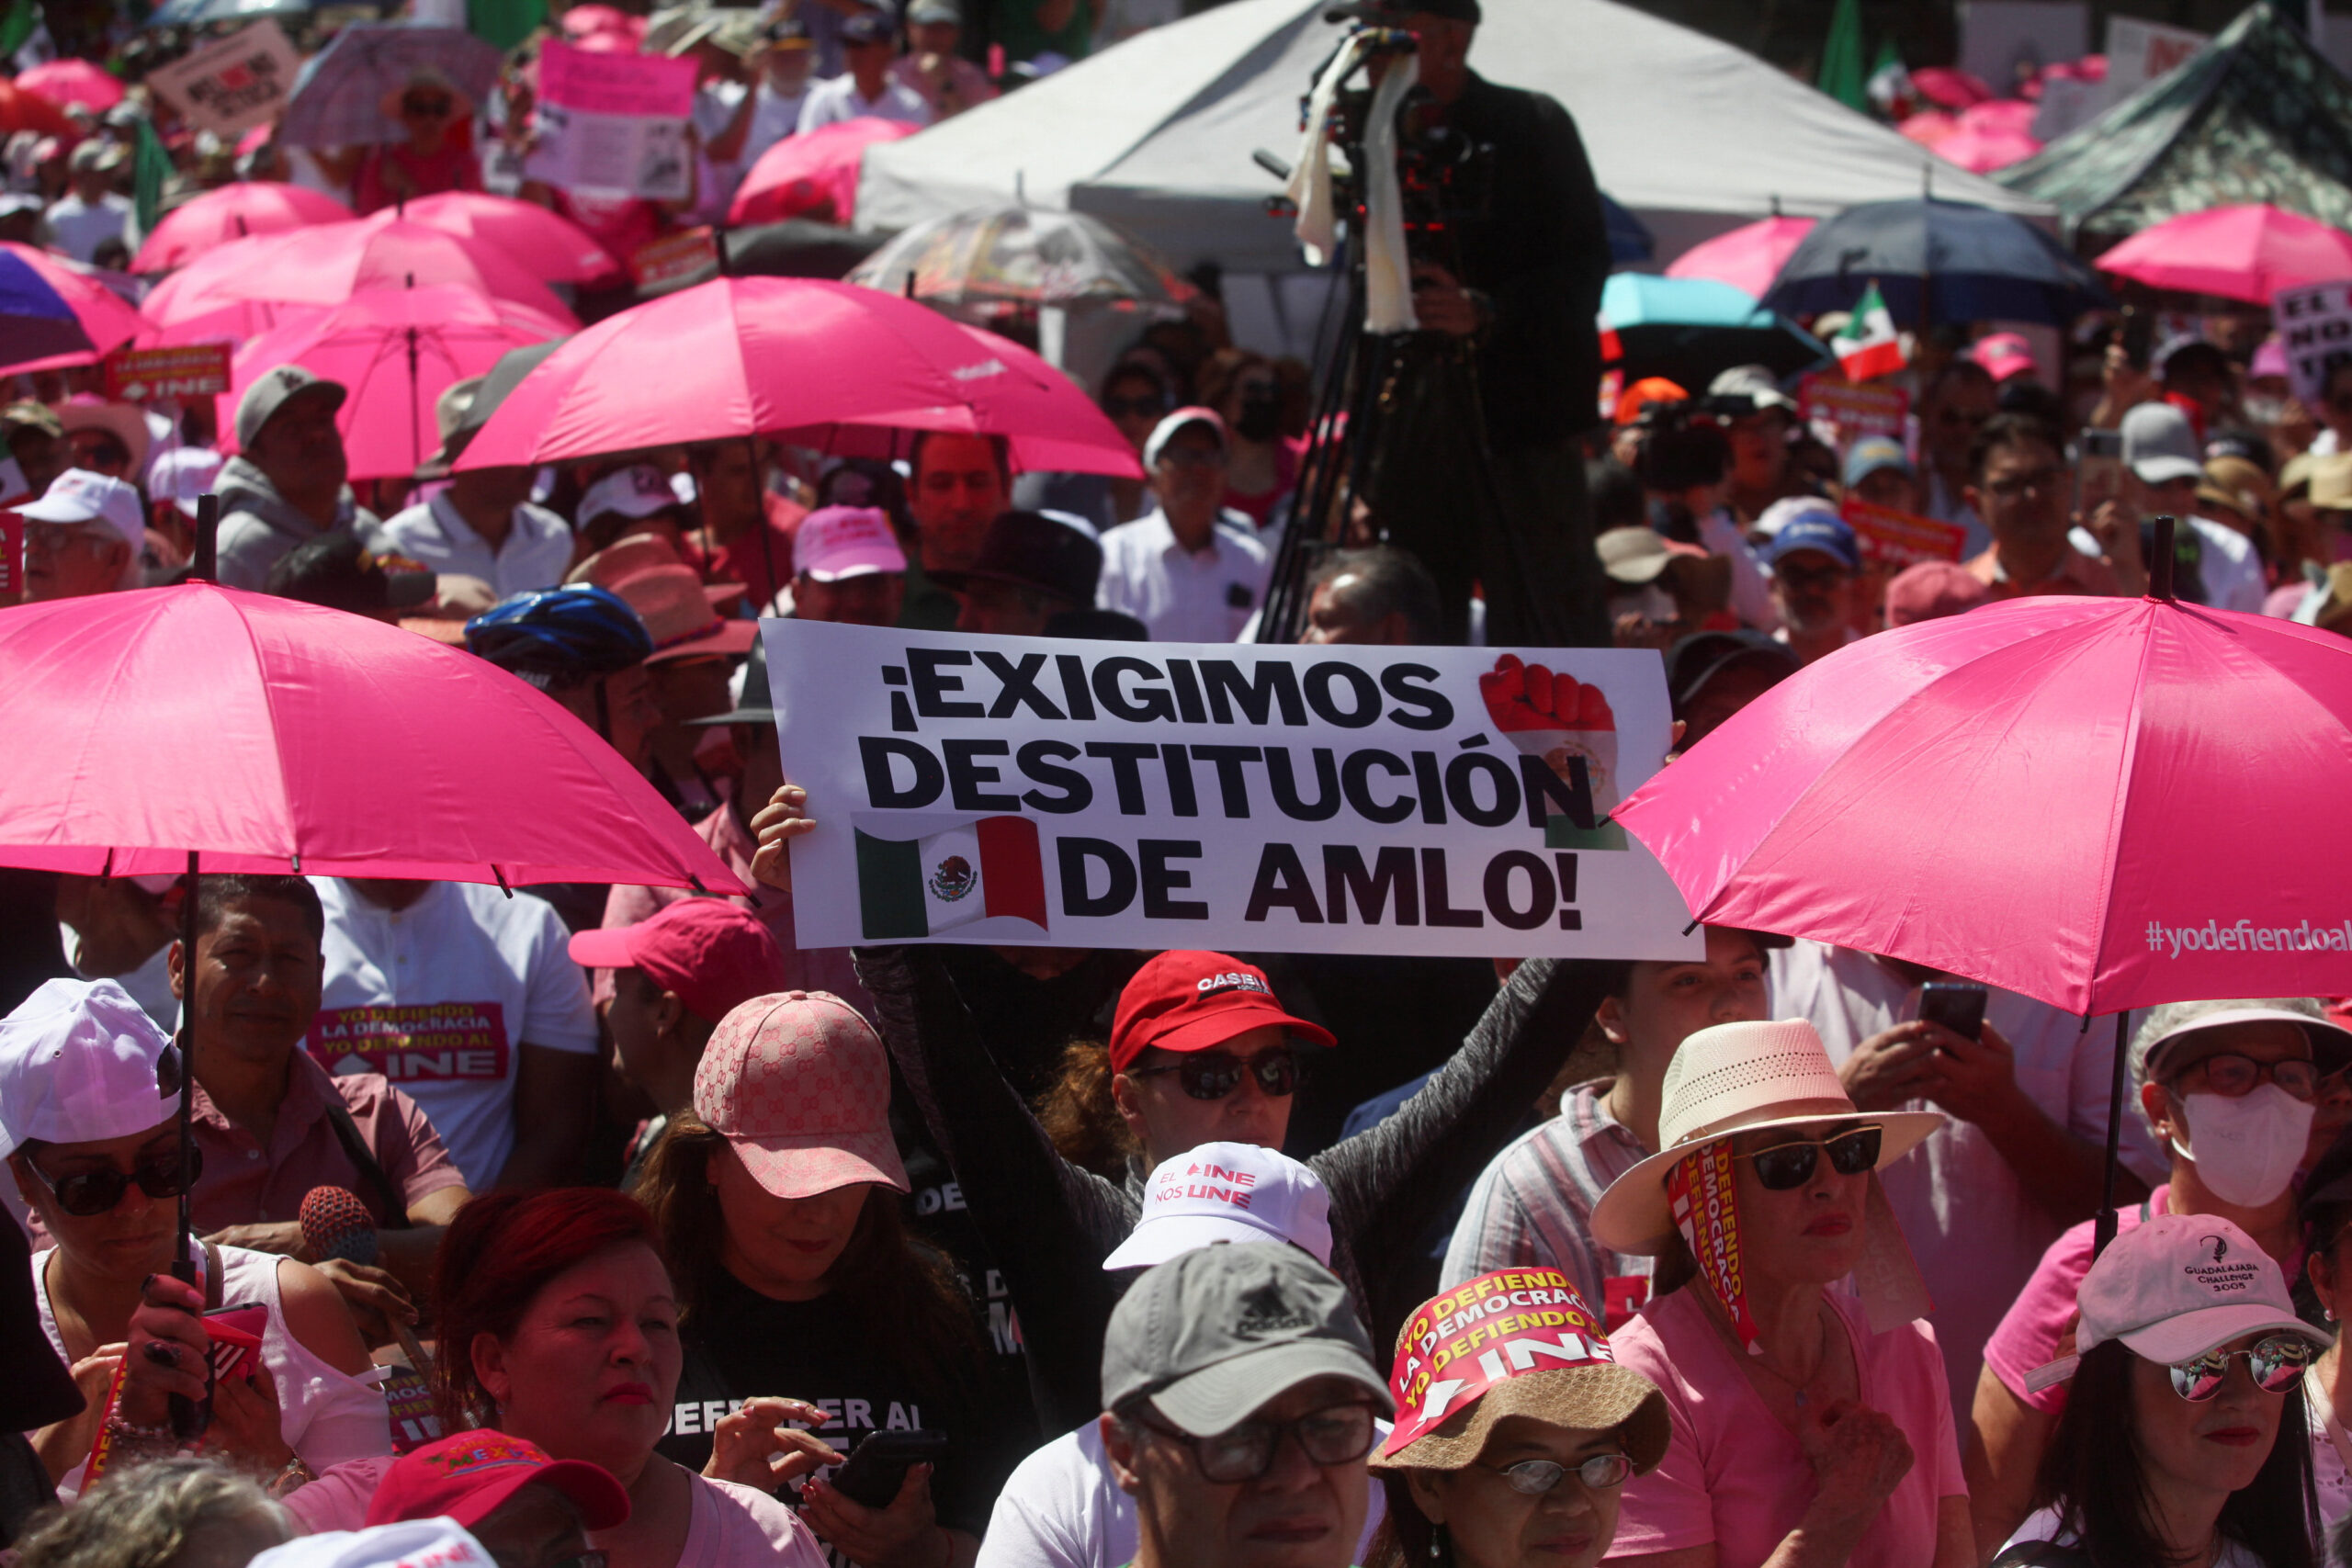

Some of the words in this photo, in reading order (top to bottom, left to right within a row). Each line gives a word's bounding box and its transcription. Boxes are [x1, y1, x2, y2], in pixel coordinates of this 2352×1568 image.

[881, 647, 1453, 732] ¡EXIGIMOS
[858, 733, 1595, 829] DESTITUCIÓN
[1057, 837, 1208, 919] DE
[1245, 843, 1581, 931] AMLO!
[322, 1023, 348, 1038] LA
[354, 1016, 491, 1035] DEMOCRACIA
[338, 1010, 366, 1023] YO
[371, 1004, 474, 1021] DEFIENDO
[323, 1040, 352, 1055] YO
[357, 1032, 463, 1052] DEFIENDO
[469, 1032, 493, 1047] AL
[386, 1050, 496, 1078] INE
[1159, 1172, 1176, 1184] EL
[1204, 1164, 1256, 1187] INE
[1155, 1186, 1183, 1204] NOS
[1702, 1143, 1740, 1324] DEMOCRACIA
[1714, 1151, 1742, 1297] DEFIENDO
[2185, 1263, 2259, 1275] GUADALAJARA
[2198, 1273, 2255, 1284] CHALLENGE
[1399, 1356, 1421, 1393] LA
[1420, 1289, 1596, 1357] DEMOCRAC
[1405, 1317, 1429, 1354] YO
[1405, 1371, 1430, 1409] YO
[1433, 1311, 1585, 1372] DEFIENDO
[1477, 1333, 1614, 1382] INE
